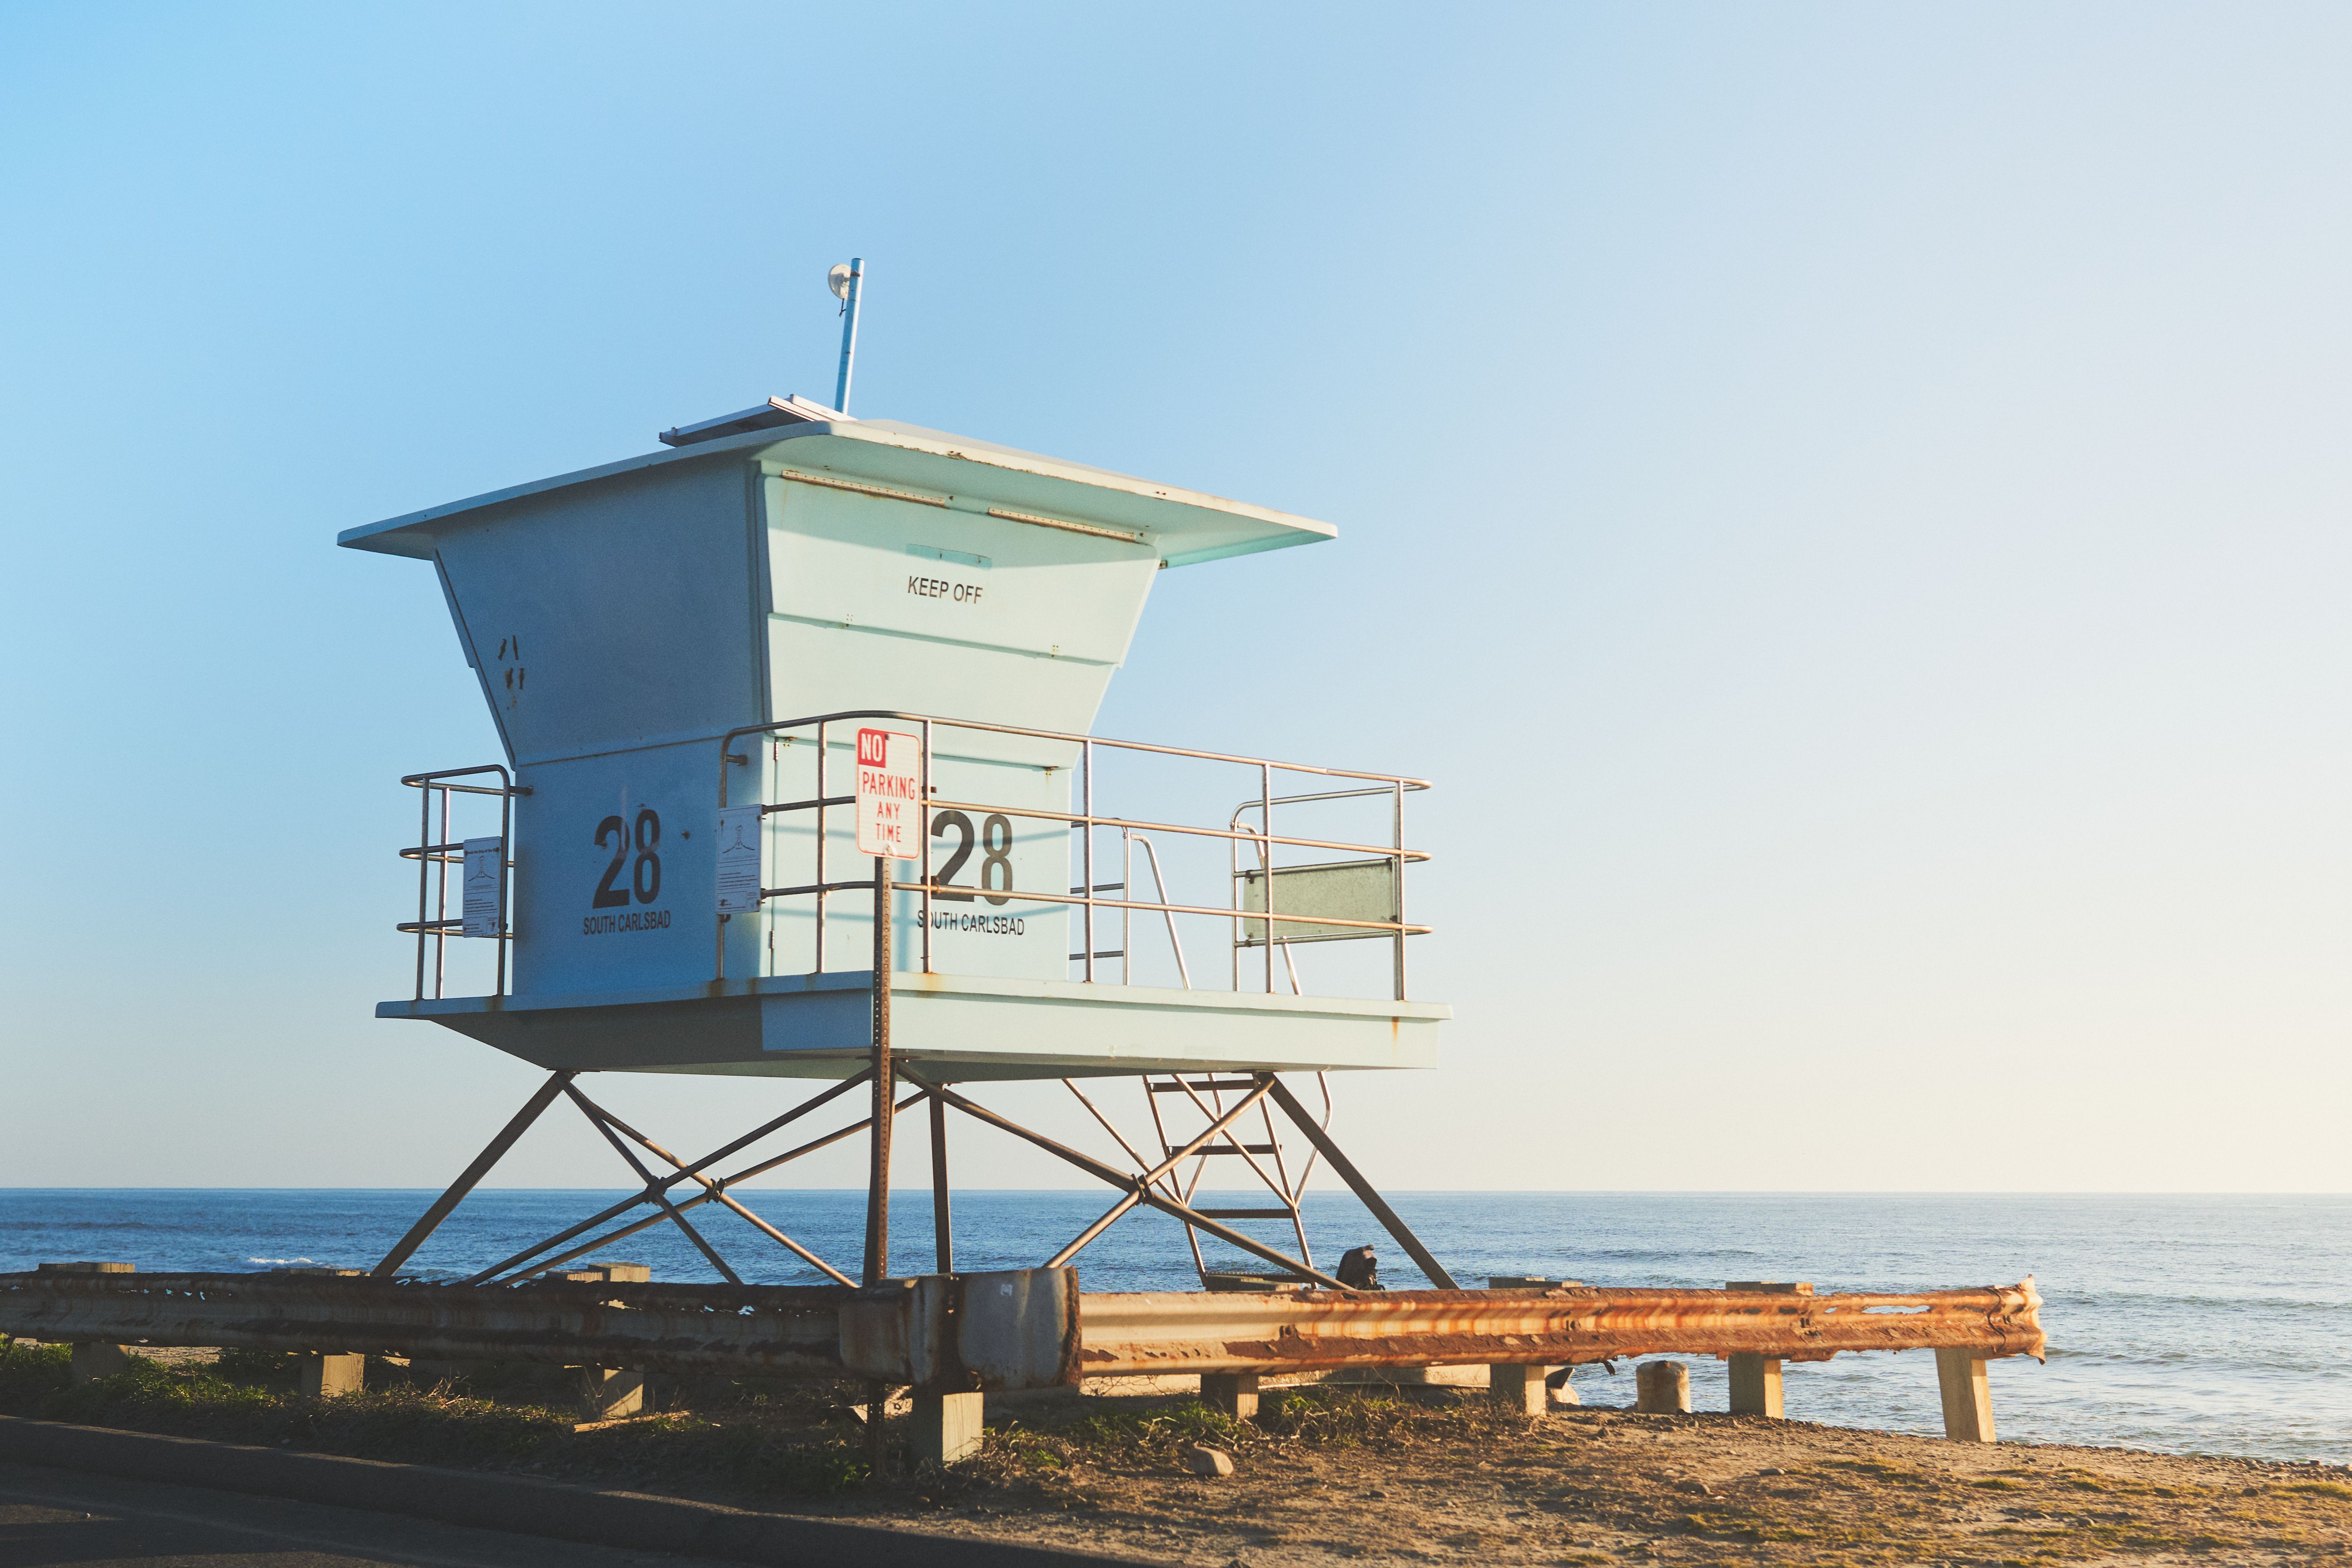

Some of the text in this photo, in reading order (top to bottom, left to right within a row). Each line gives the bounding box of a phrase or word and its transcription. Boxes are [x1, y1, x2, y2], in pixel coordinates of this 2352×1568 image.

[908, 576, 983, 604] KEEP OFF
[861, 733, 883, 762] NO
[863, 771, 915, 800] PARKING
[877, 801, 900, 820] ANY
[876, 823, 901, 842] TIME
[592, 809, 660, 909] 28
[930, 810, 1012, 906] 28
[583, 910, 671, 935] SOUTH CARLSBAD
[962, 914, 1024, 936] CARLSBAD
